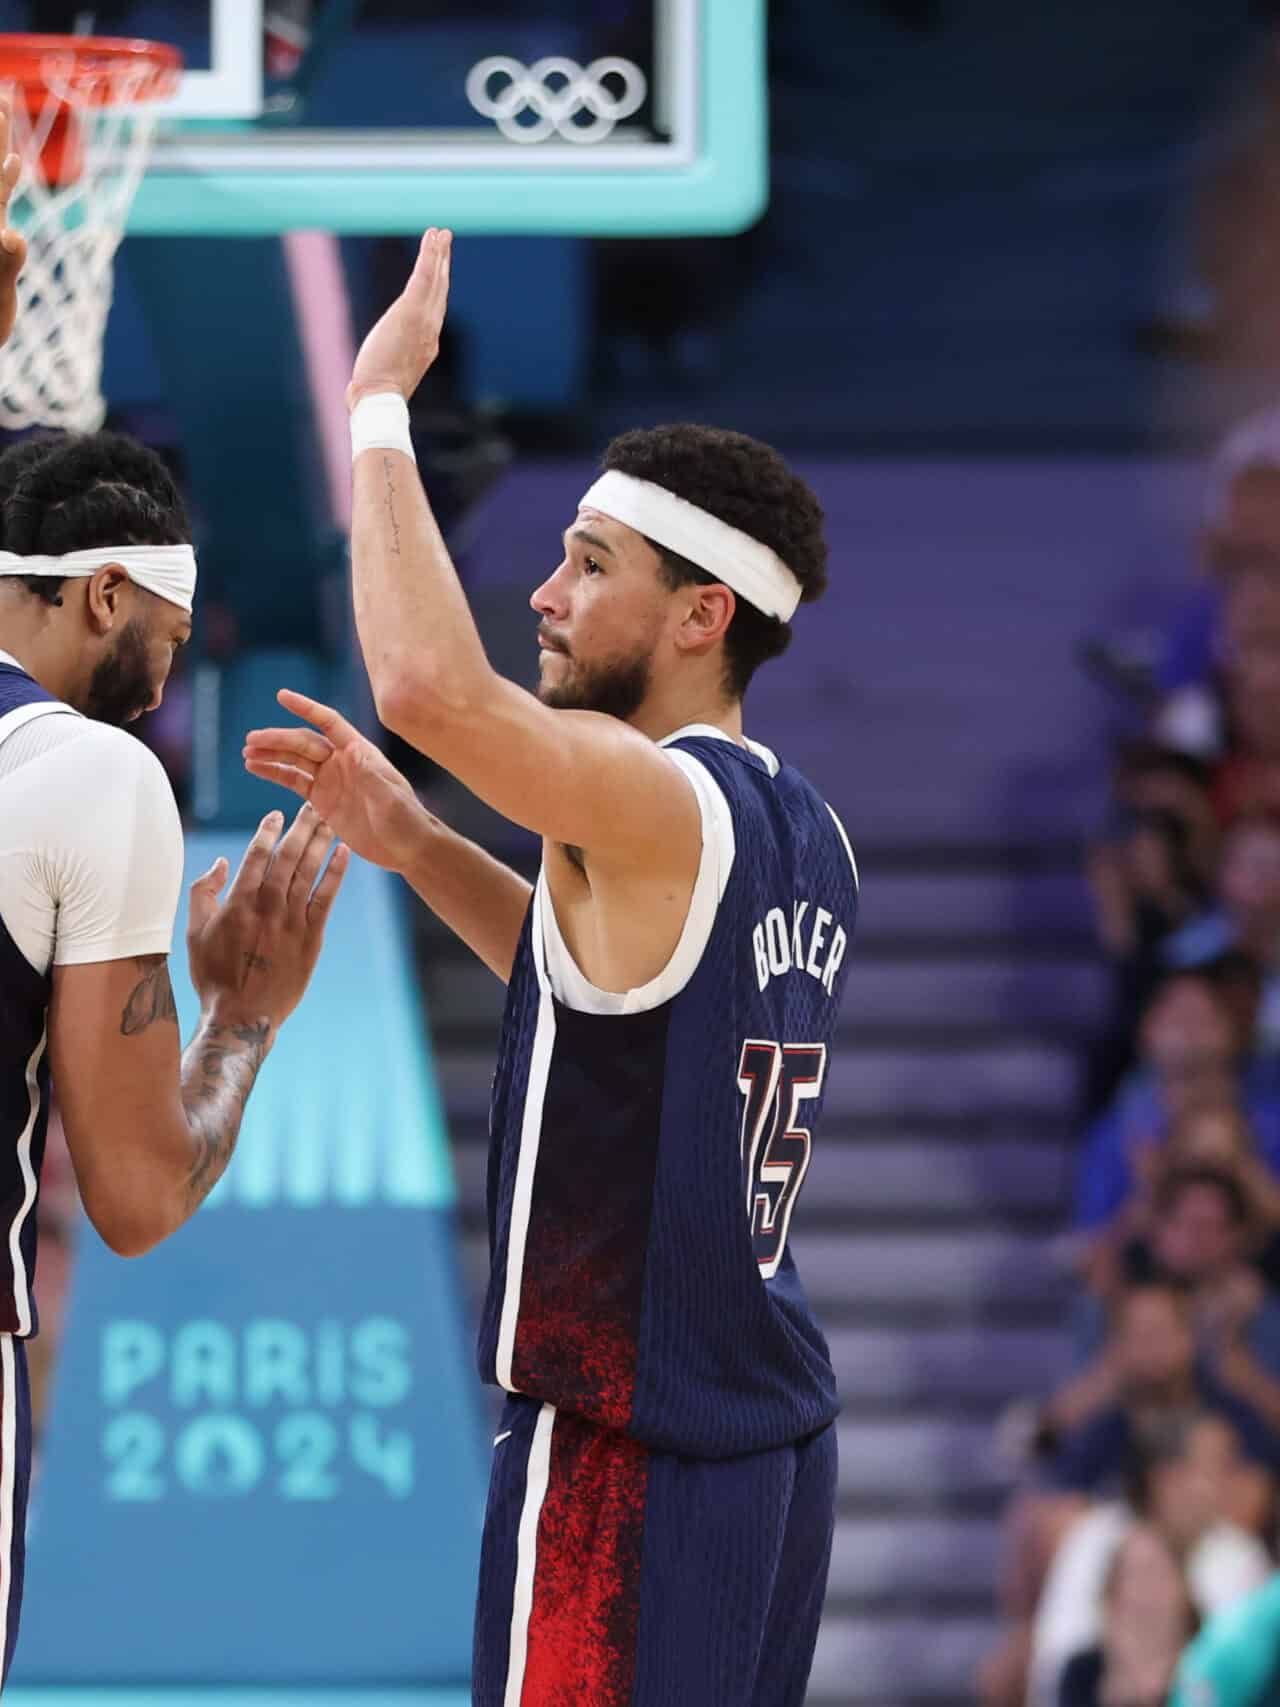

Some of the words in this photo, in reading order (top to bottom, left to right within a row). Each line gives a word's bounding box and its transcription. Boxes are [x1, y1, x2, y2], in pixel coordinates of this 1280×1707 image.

[752, 899, 847, 997] BOKER
[737, 1039, 825, 1279] 15
[101, 1317, 412, 1407] PARIS
[101, 1409, 415, 1501] 2024
